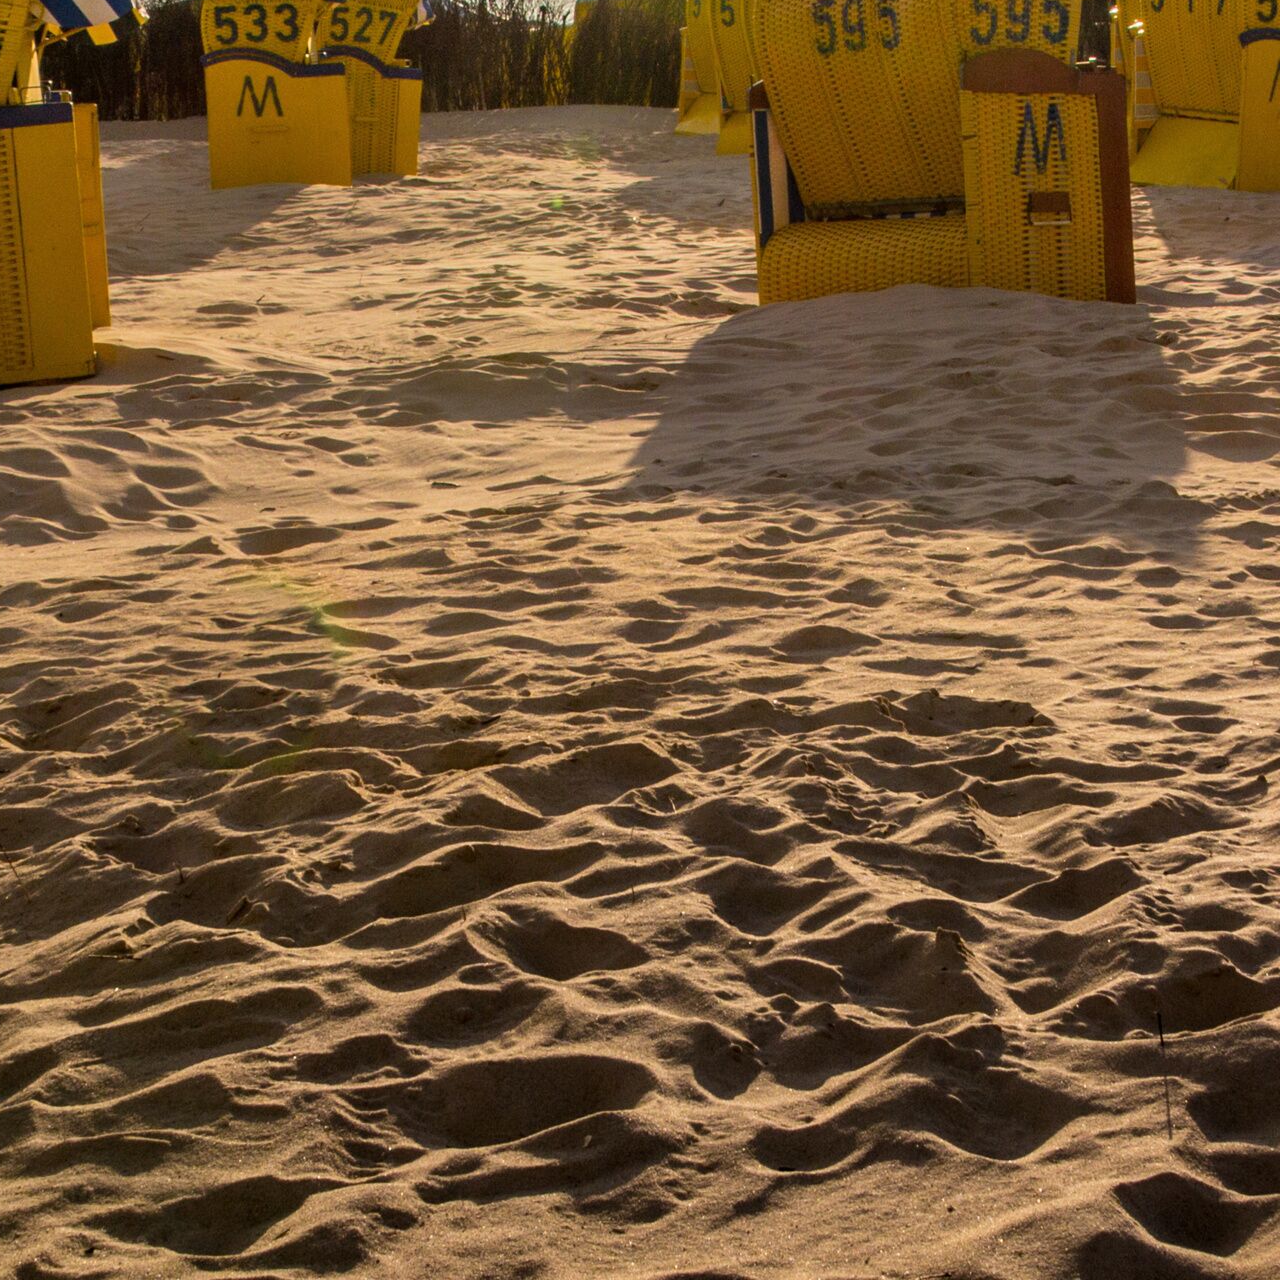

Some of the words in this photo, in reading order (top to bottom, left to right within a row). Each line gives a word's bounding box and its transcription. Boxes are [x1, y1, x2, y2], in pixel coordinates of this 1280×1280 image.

[214, 4, 299, 45] 533
[330, 7, 398, 46] 527
[237, 76, 283, 118] M
